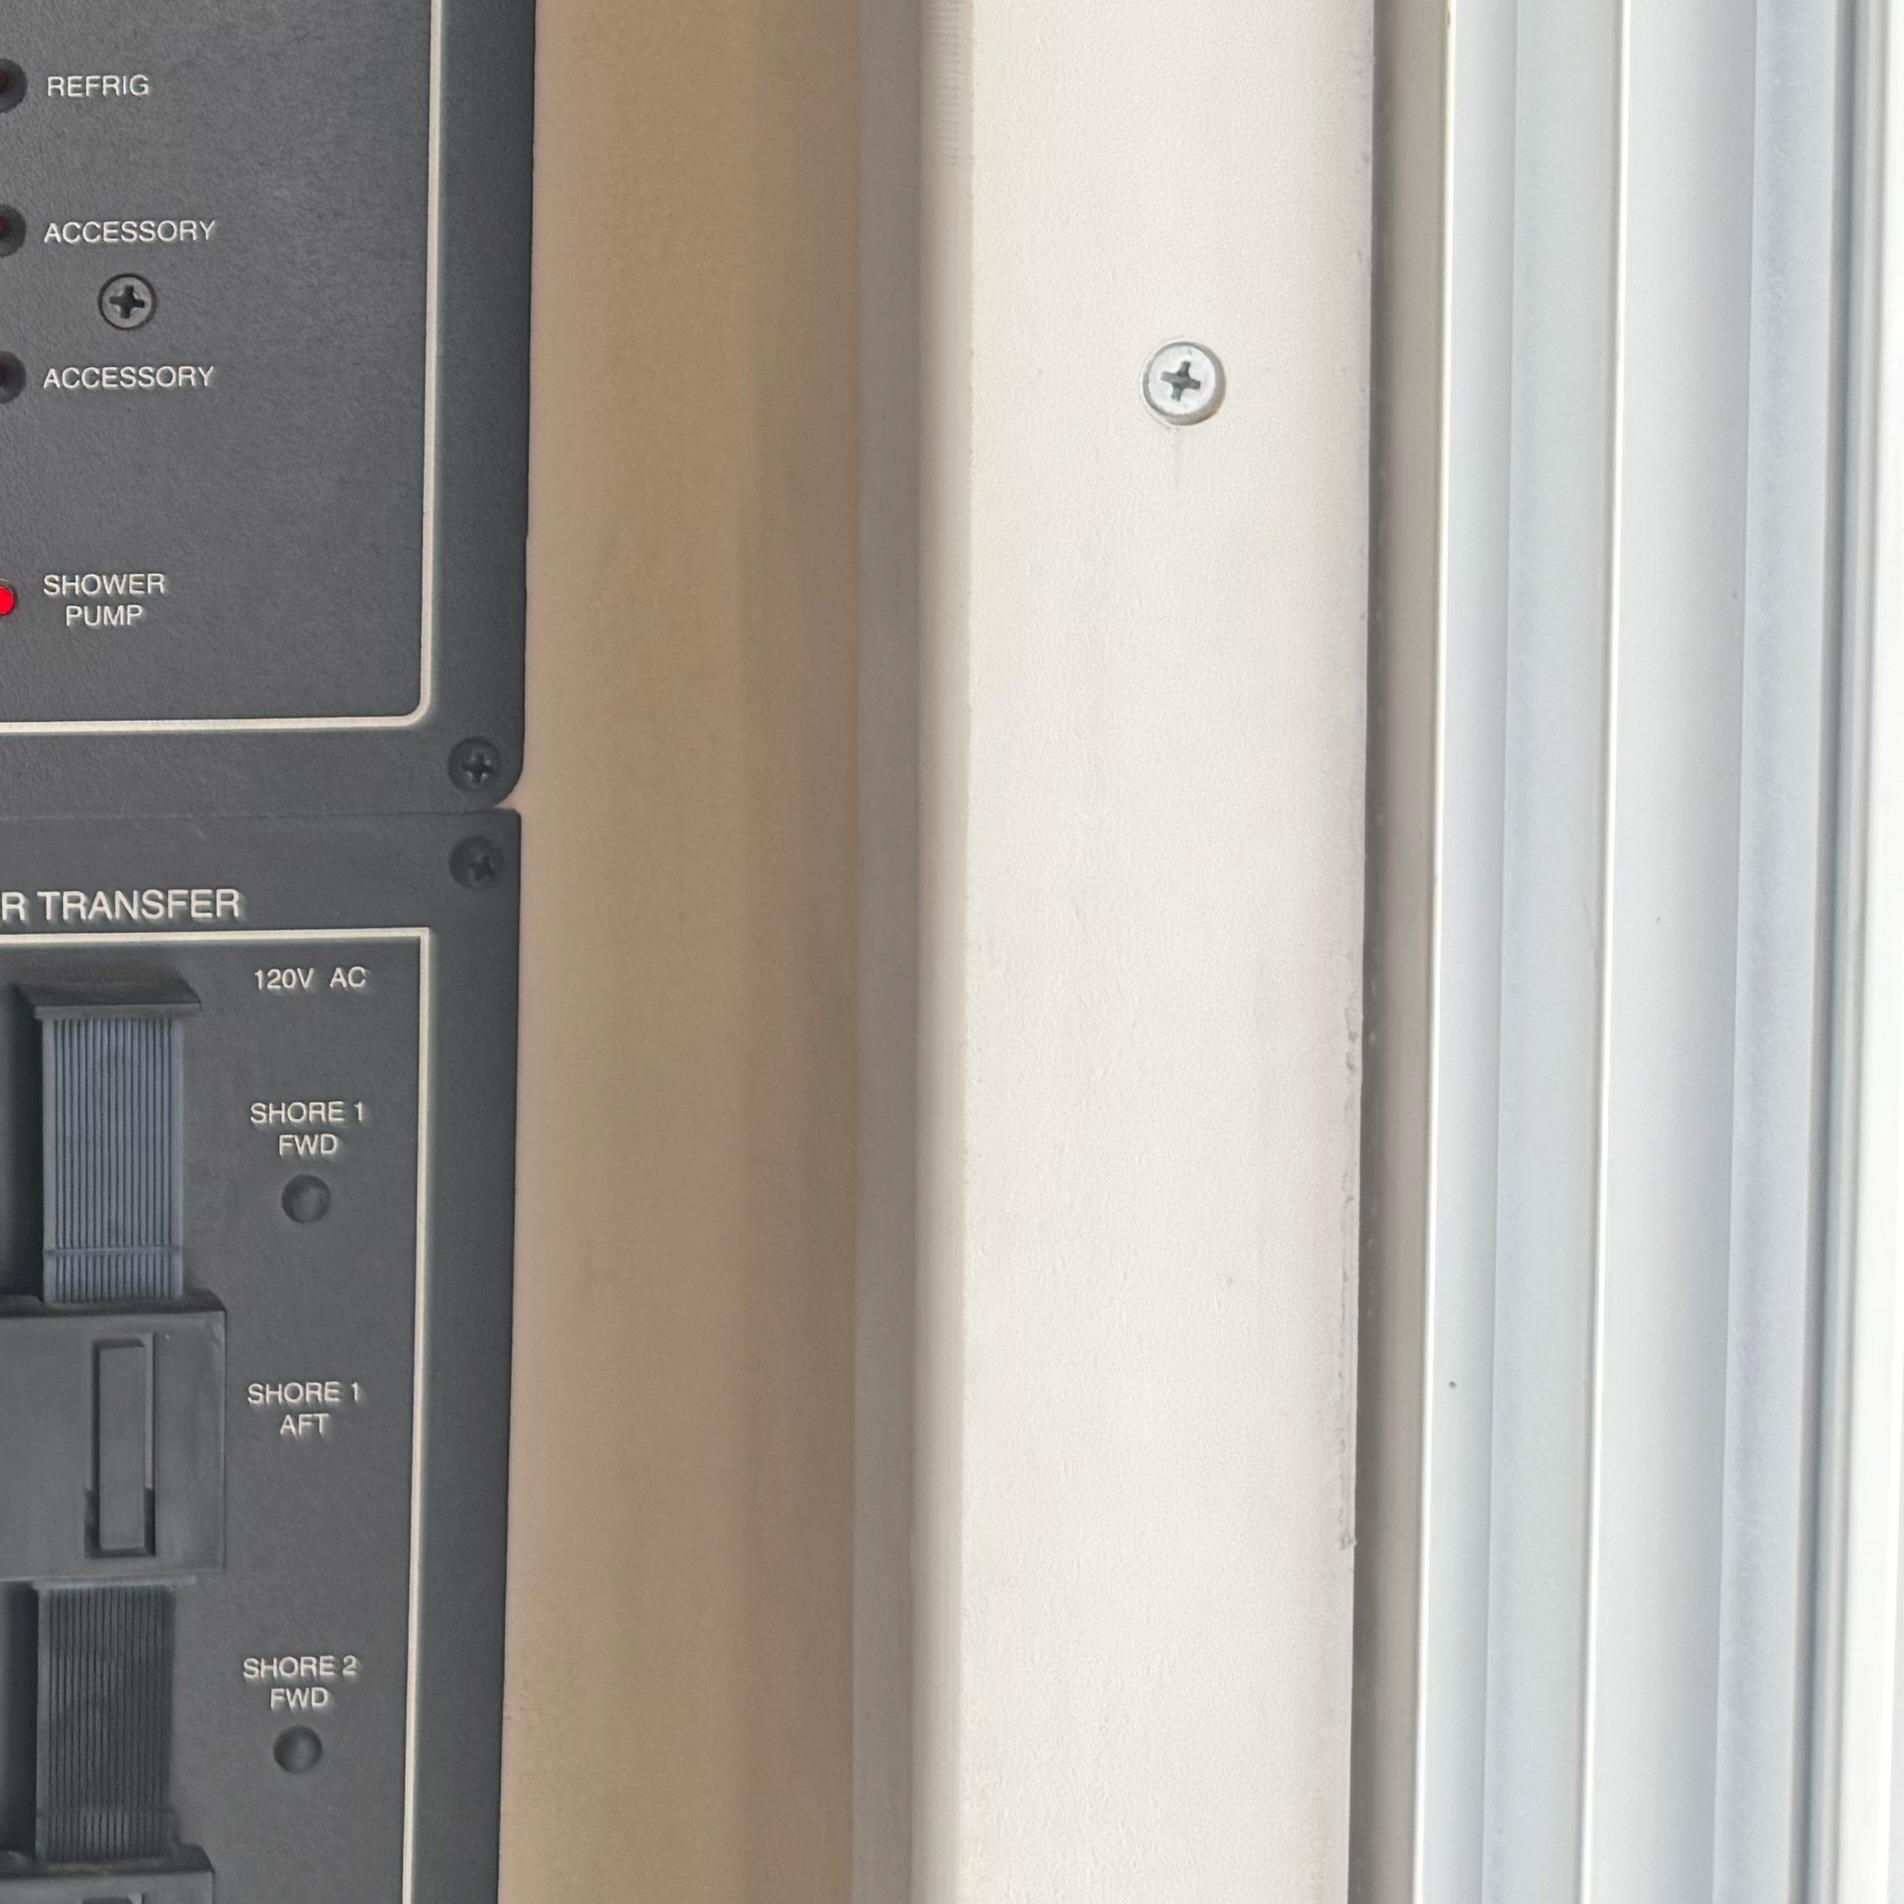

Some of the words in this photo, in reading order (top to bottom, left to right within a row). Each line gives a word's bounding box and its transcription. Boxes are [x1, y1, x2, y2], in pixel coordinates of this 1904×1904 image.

[47, 74, 150, 98] REFRIG
[43, 219, 216, 244] ACCESSORY
[43, 573, 166, 597] SHOWER
[65, 604, 144, 628] PUMP
[37, 888, 240, 920] TRANSFER
[255, 968, 314, 991] 120V
[329, 966, 366, 989] AC
[250, 1100, 345, 1125] SHORE
[355, 1102, 364, 1122] 1
[279, 1133, 339, 1156] FWD
[243, 1655, 335, 1680] SHORE
[342, 1655, 357, 1677] 2
[270, 1687, 330, 1709] FWD
